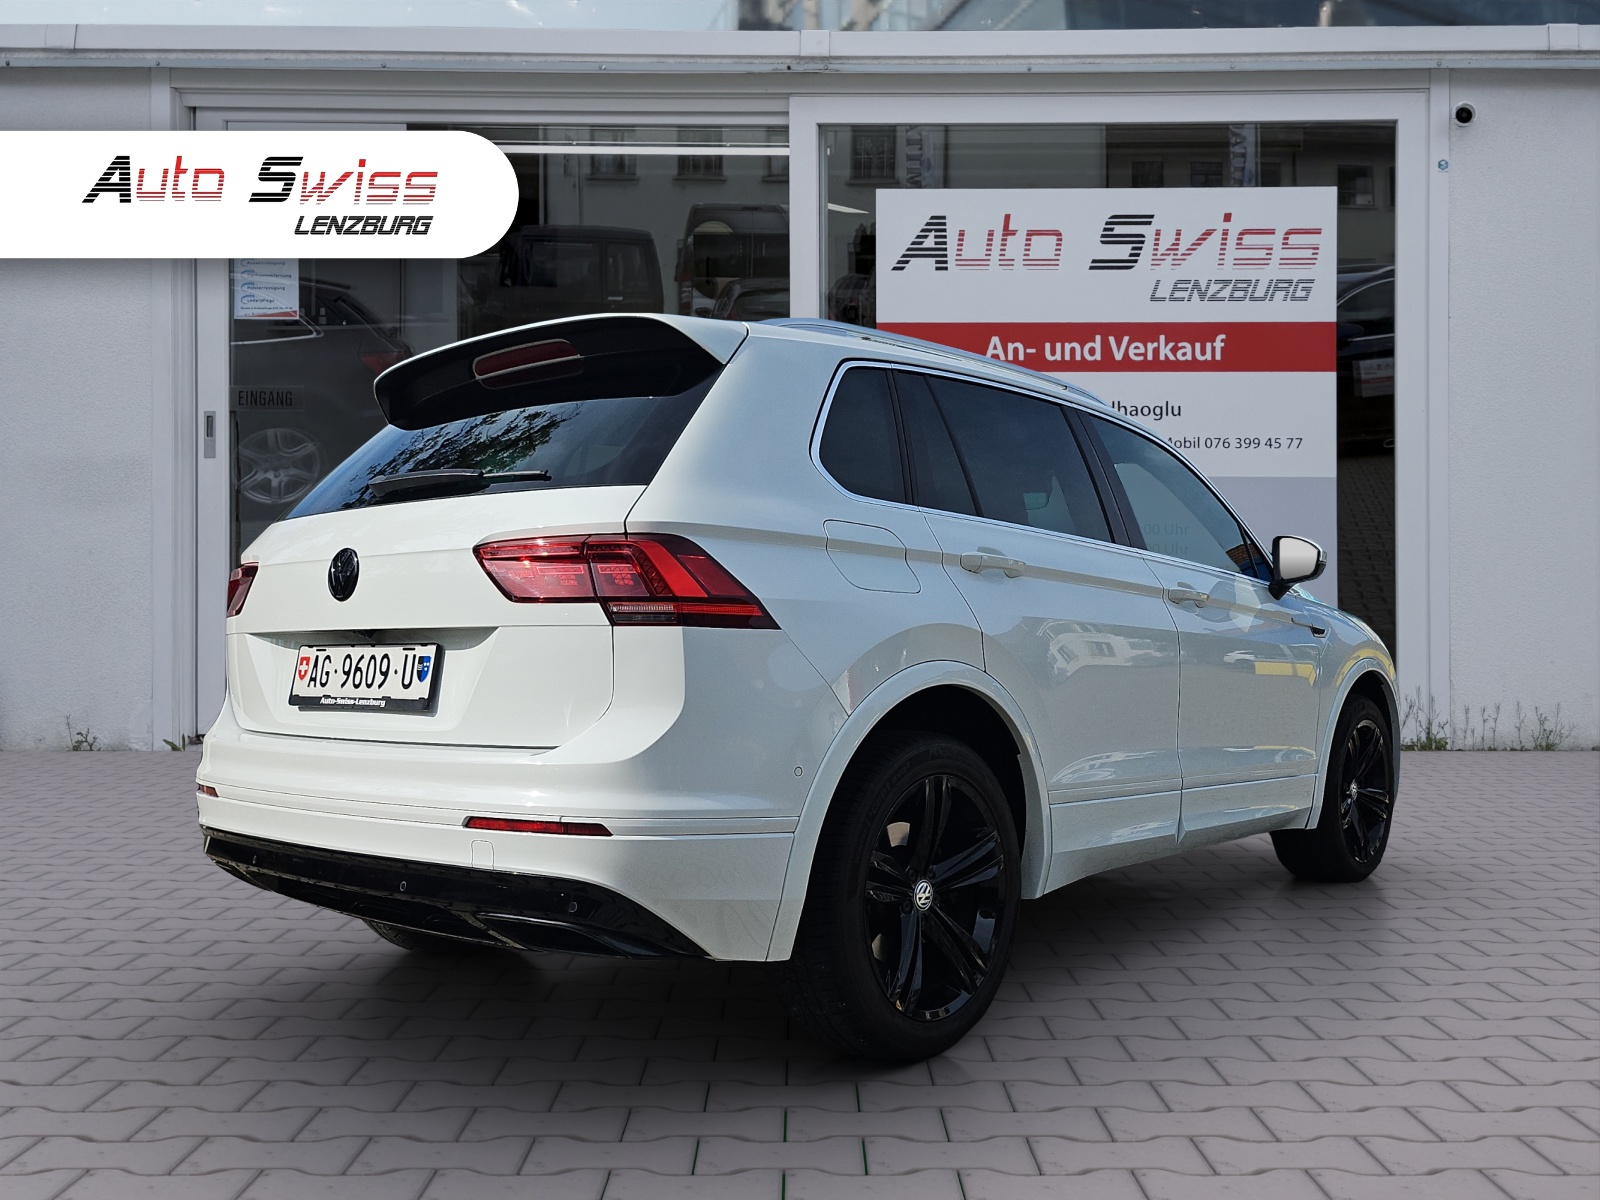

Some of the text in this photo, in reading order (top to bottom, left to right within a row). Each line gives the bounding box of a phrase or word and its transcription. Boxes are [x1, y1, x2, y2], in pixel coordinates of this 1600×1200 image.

[890, 212, 1323, 271] Auto Swiss
[1149, 278, 1316, 302] LENZBURG
[986, 334, 1226, 361] An- und Verkauf
[238, 390, 293, 407] EINGANG
[1204, 437, 1231, 449] 076
[1234, 437, 1261, 449] 399
[1264, 437, 1283, 449] 45
[1286, 437, 1304, 449] 77
[1164, 522, 1190, 536] Uhr
[1164, 542, 1190, 555] Uhr
